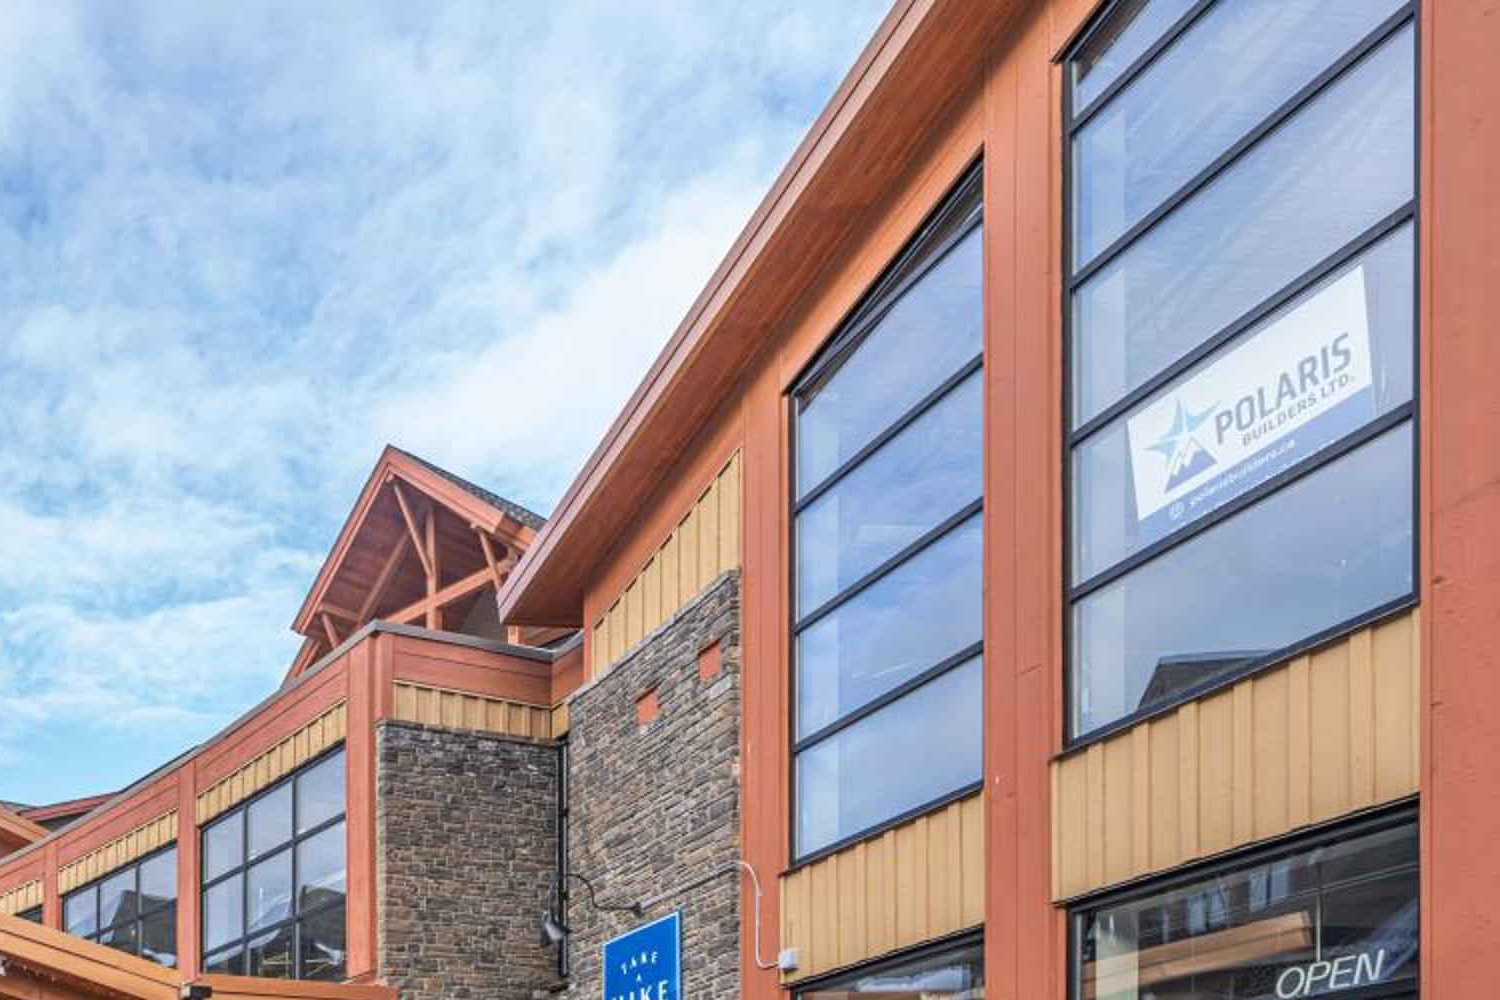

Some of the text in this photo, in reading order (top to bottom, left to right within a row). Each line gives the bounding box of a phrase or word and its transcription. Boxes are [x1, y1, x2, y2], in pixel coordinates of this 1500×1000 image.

[1215, 332, 1351, 445] POLARIS
[1243, 374, 1355, 446] BUILDERS LTD.
[621, 951, 658, 974] TAKE
[636, 973, 642, 982] A
[1276, 949, 1385, 998] OPEN
